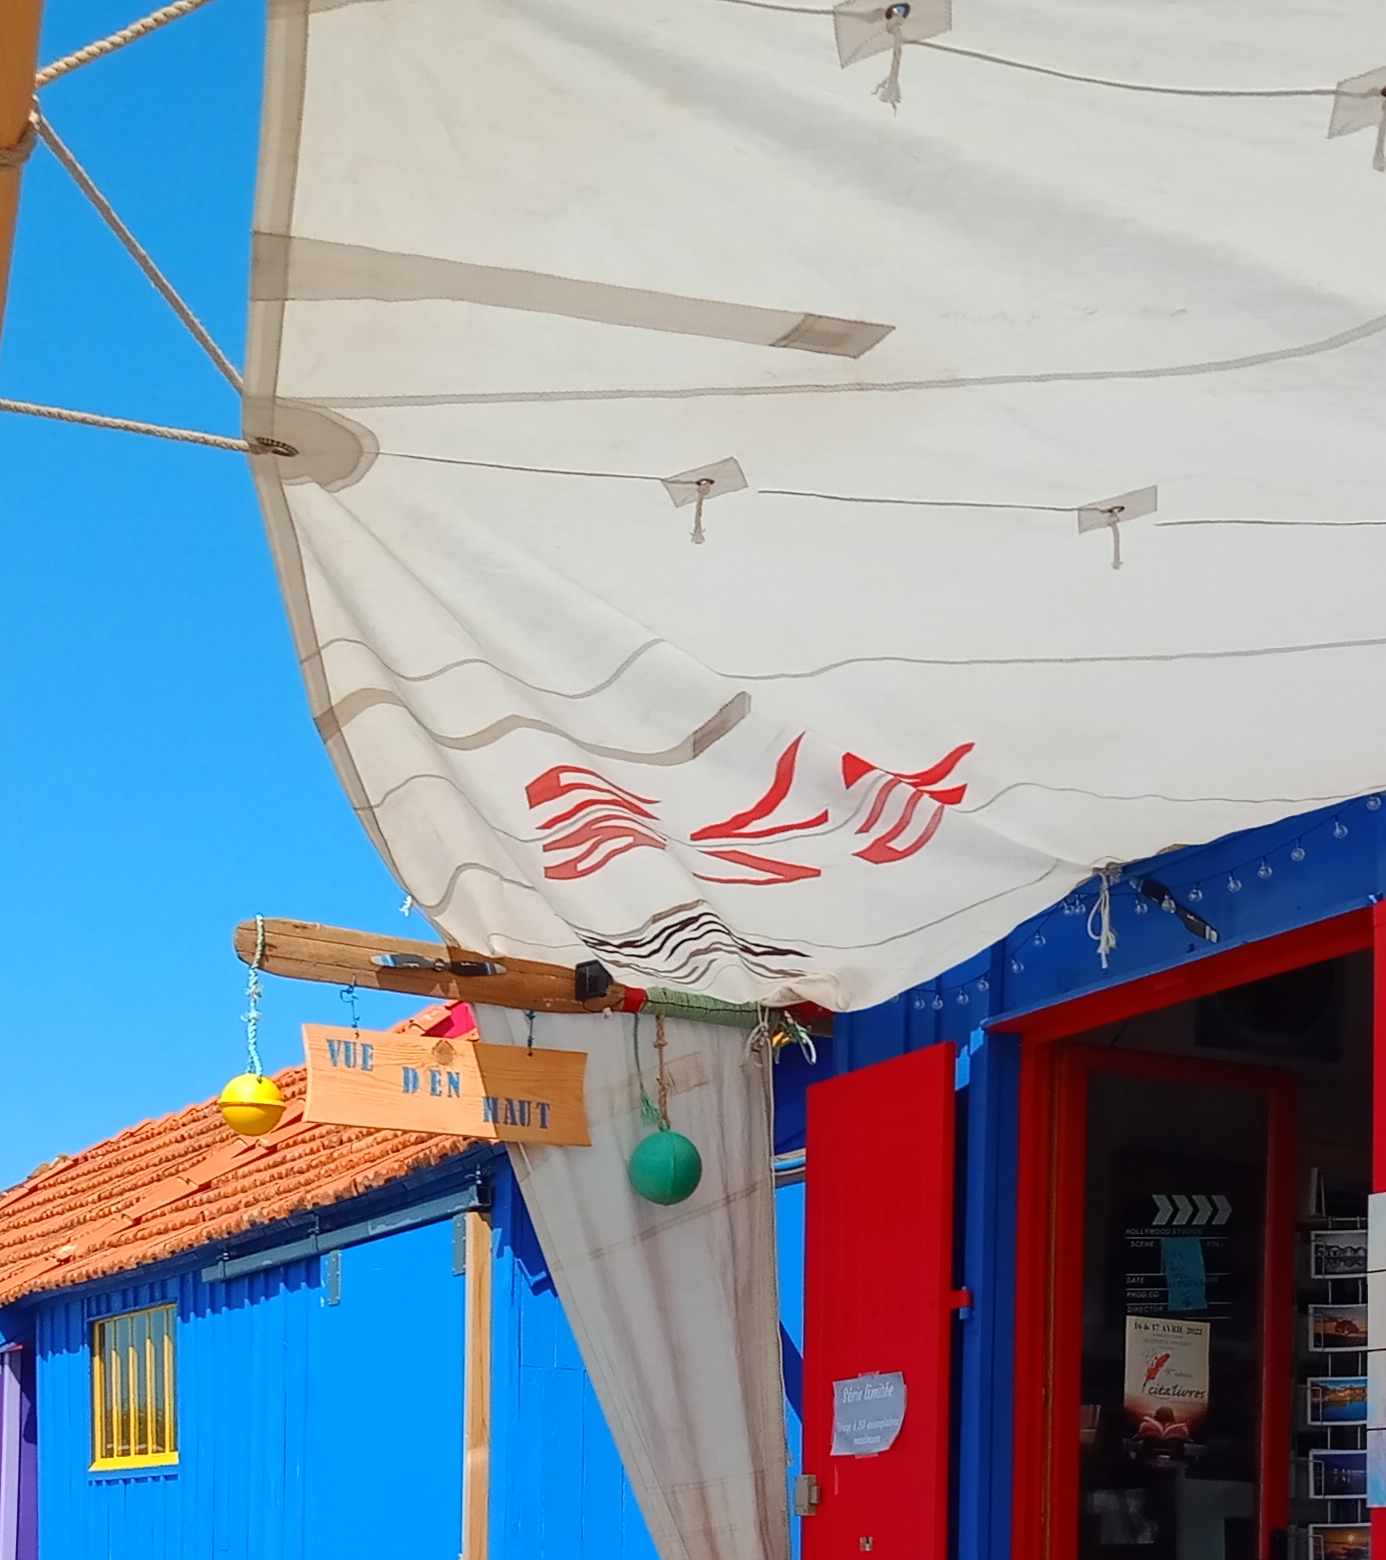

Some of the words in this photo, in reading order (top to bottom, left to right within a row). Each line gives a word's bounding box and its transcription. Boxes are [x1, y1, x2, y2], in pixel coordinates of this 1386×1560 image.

[326, 1038, 374, 1071] VUE
[482, 1096, 551, 1129] HAUT
[1125, 1227, 1171, 1235] HOLLYWOOD
[1172, 1227, 1203, 1235] STUDIOS
[1130, 1240, 1155, 1248] SCENE
[1126, 1276, 1145, 1284] DATE
[1126, 1305, 1164, 1313] DIRECTOR
[1162, 1324, 1183, 1334] AVRIL
[842, 1386, 863, 1404] Série
[864, 1380, 894, 1401] limitée
